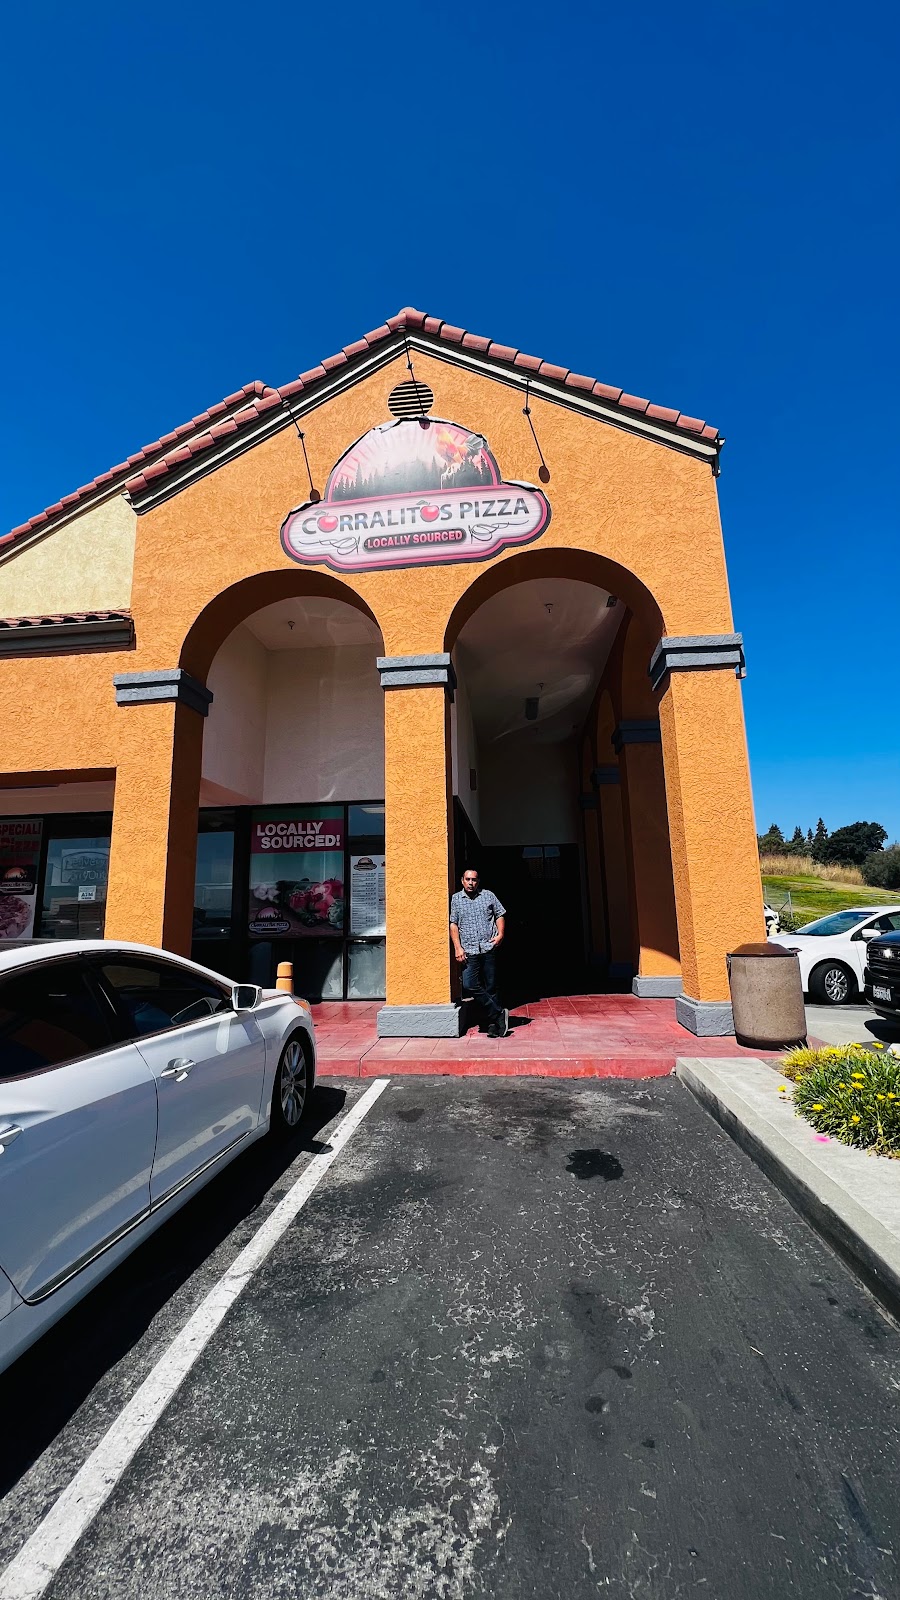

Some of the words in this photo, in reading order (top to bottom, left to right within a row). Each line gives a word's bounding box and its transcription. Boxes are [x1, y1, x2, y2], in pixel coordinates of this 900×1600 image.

[302, 500, 453, 534] CORRALITOS
[460, 497, 530, 519] PIZZA
[367, 535, 411, 548] LOCALLY
[413, 530, 463, 543] SOURCED
[0, 821, 41, 836] PECIAL!
[256, 822, 324, 837] LOCALLY
[260, 834, 340, 849] SOURCED!
